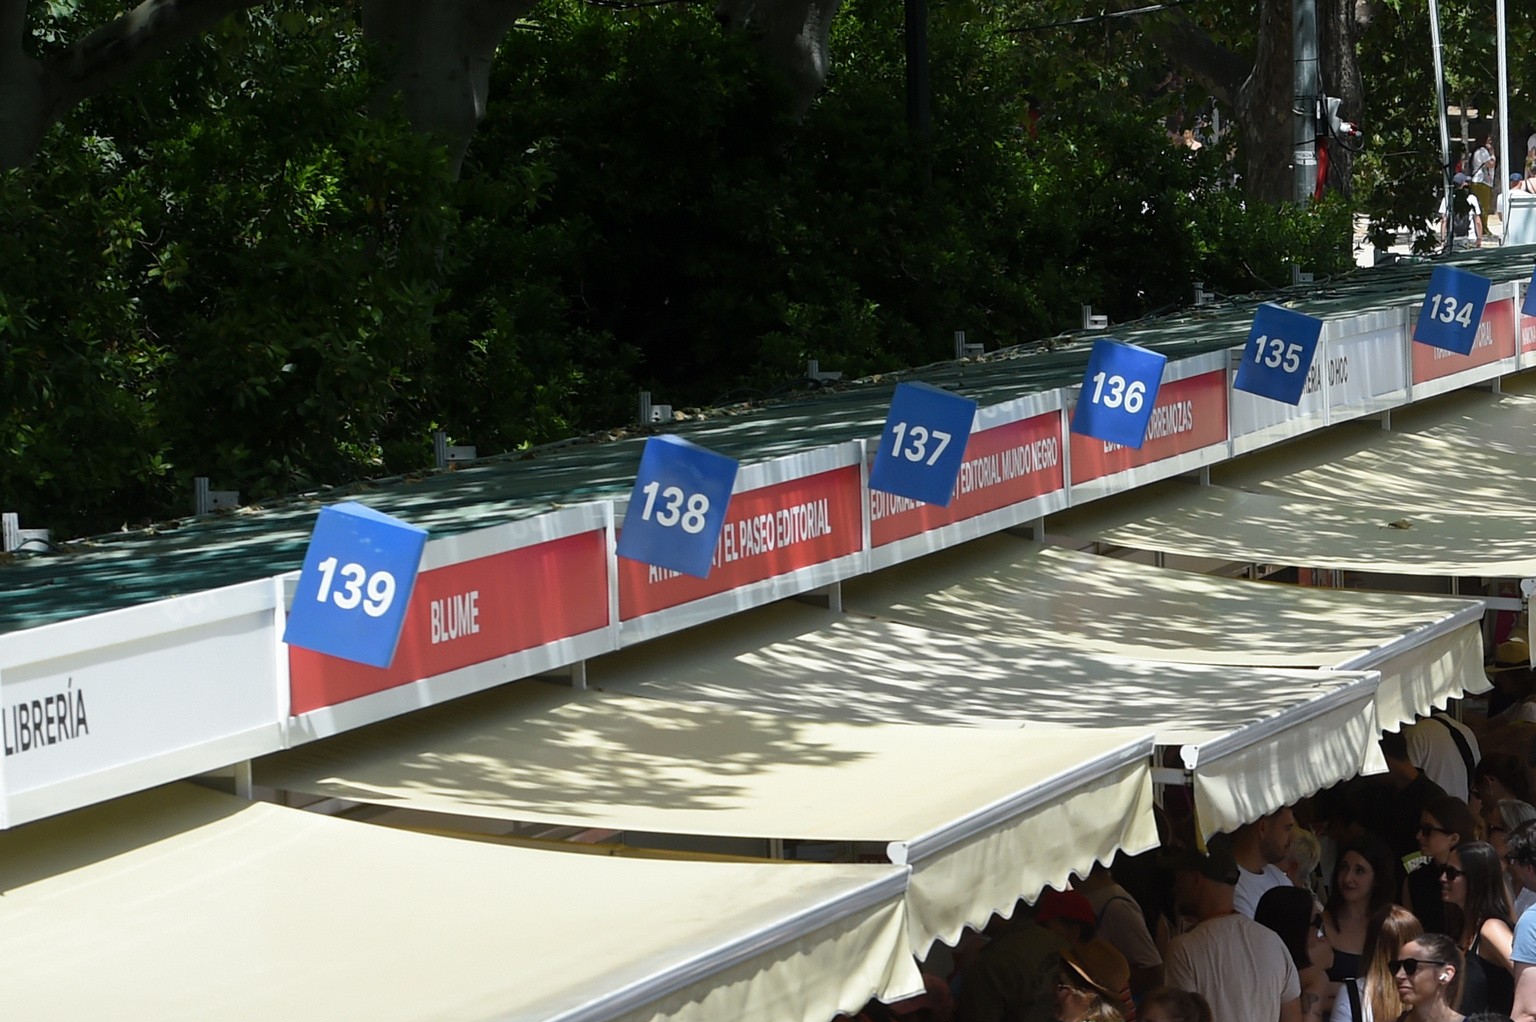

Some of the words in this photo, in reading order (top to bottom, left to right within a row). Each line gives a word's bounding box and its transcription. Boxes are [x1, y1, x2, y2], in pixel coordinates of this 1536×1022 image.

[1429, 293, 1474, 329] 134
[1254, 334, 1304, 374] 135
[1092, 371, 1147, 414] 136
[891, 421, 952, 467] 137
[960, 453, 1002, 495] EDITORIAL
[1002, 445, 1031, 482] MUNDO
[1031, 436, 1058, 472] NEGRO
[641, 480, 710, 534] 138
[723, 522, 739, 562] EL
[739, 512, 775, 559] PASEO
[775, 497, 832, 549] EDITORIAL
[317, 556, 396, 618] 139
[430, 590, 480, 645] BLUME
[1, 677, 90, 757] LIBRERÍA
